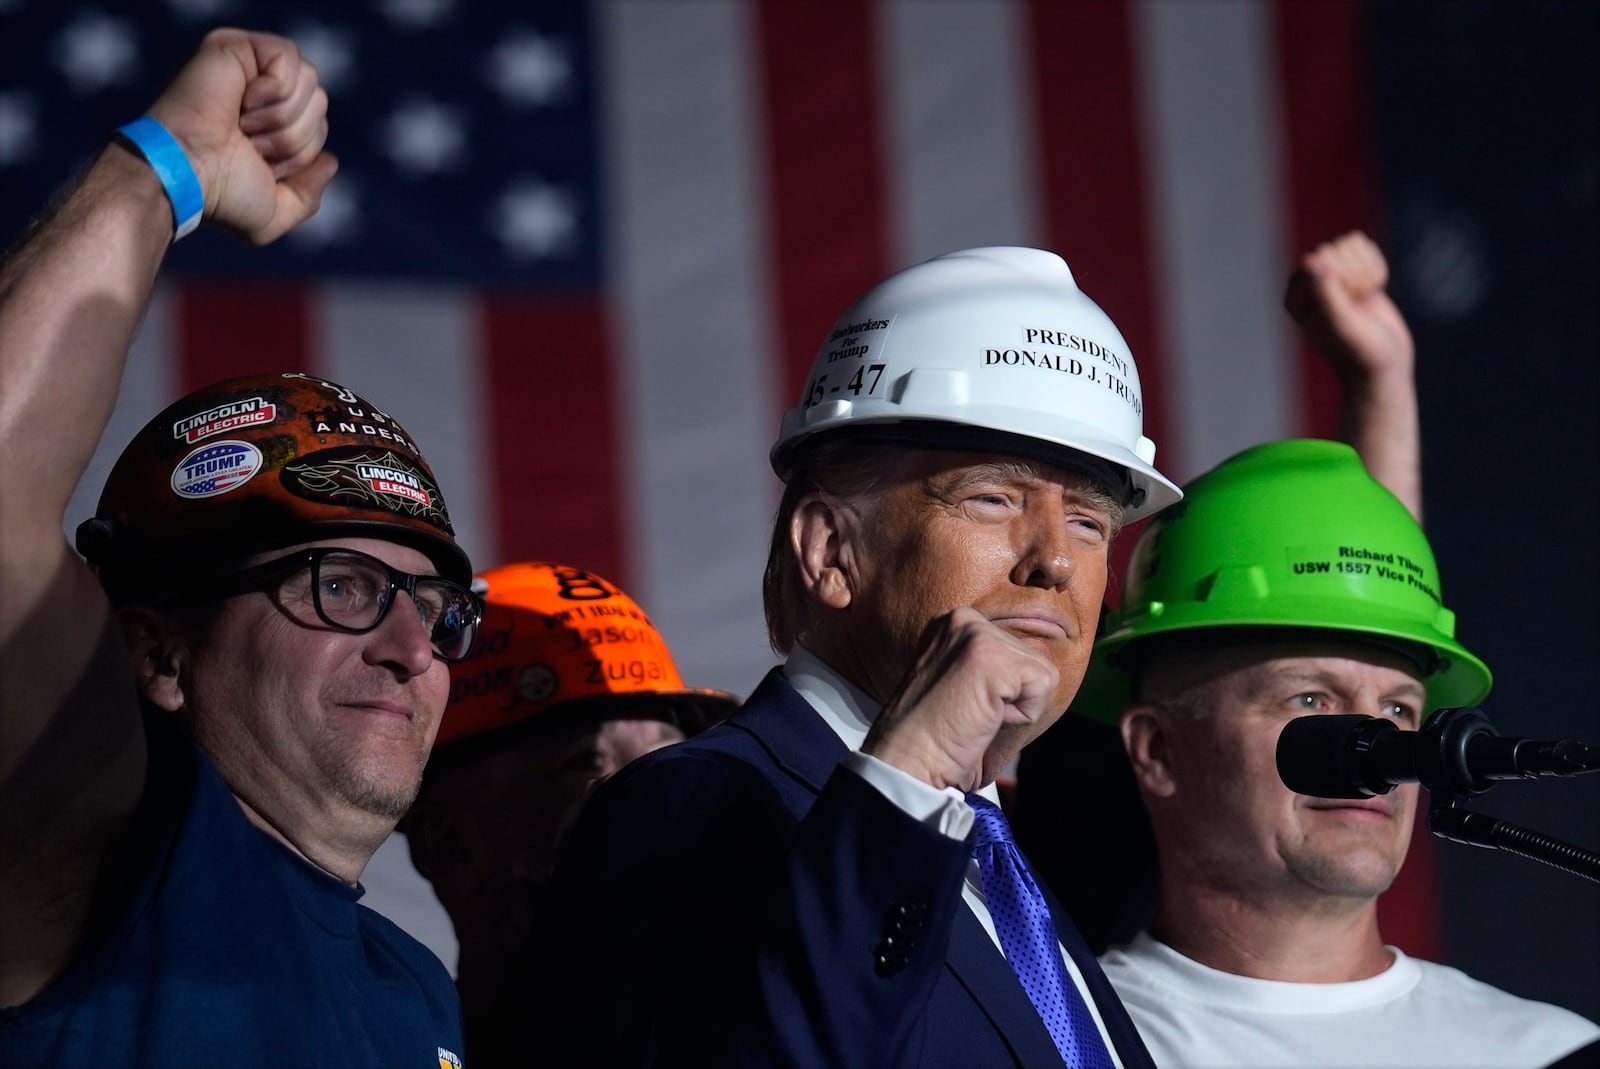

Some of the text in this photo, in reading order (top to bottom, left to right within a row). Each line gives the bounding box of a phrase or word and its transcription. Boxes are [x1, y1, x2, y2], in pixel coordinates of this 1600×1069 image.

[827, 345, 869, 363] Trump
[1026, 328, 1128, 377] PRESIDENT
[986, 350, 1082, 375] DONALD
[1088, 366, 1100, 383] J.
[848, 364, 886, 396] 47
[180, 401, 255, 433] LINCOLN
[197, 412, 265, 437] ELECTRIC
[185, 454, 246, 479] TRUMP
[361, 466, 419, 488] LINCOLN
[379, 482, 426, 502] ELECTRIC
[1339, 546, 1394, 564] Richard
[1293, 562, 1331, 574] USW
[1336, 562, 1372, 574] 1557
[1377, 566, 1405, 582] Vice
